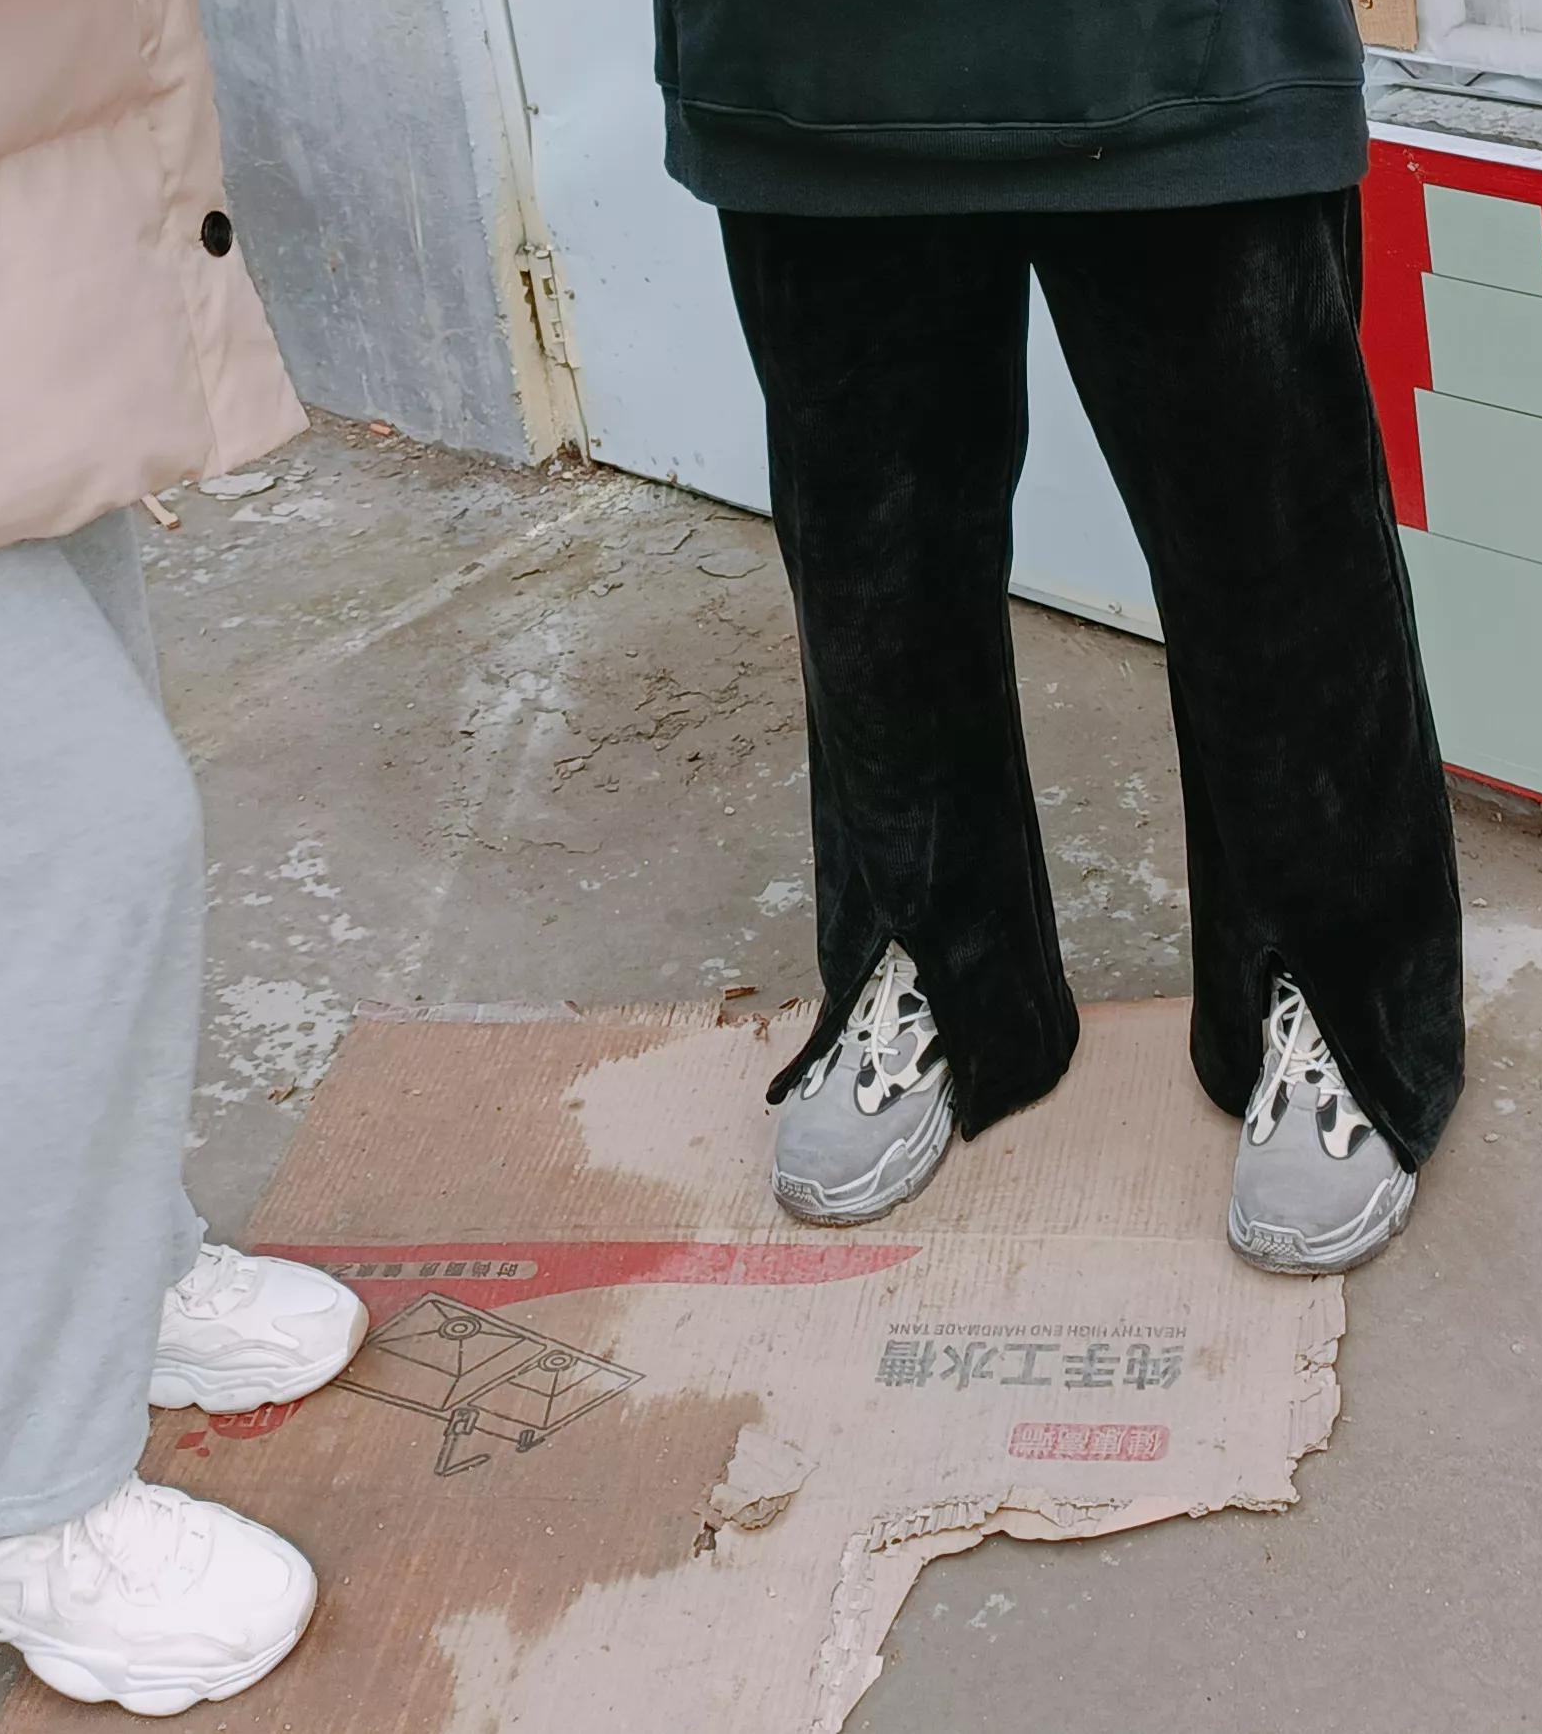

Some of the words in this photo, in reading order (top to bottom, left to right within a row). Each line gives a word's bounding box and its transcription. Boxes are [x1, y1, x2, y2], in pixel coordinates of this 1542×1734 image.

[889, 1322, 932, 1336] TANK
[934, 1322, 1027, 1337] HANDMADE
[1030, 1323, 1064, 1337] END
[1067, 1324, 1109, 1338] HIGH
[1111, 1325, 1188, 1339] HEALTHY
[875, 1339, 1185, 1391] 纯手工水槽
